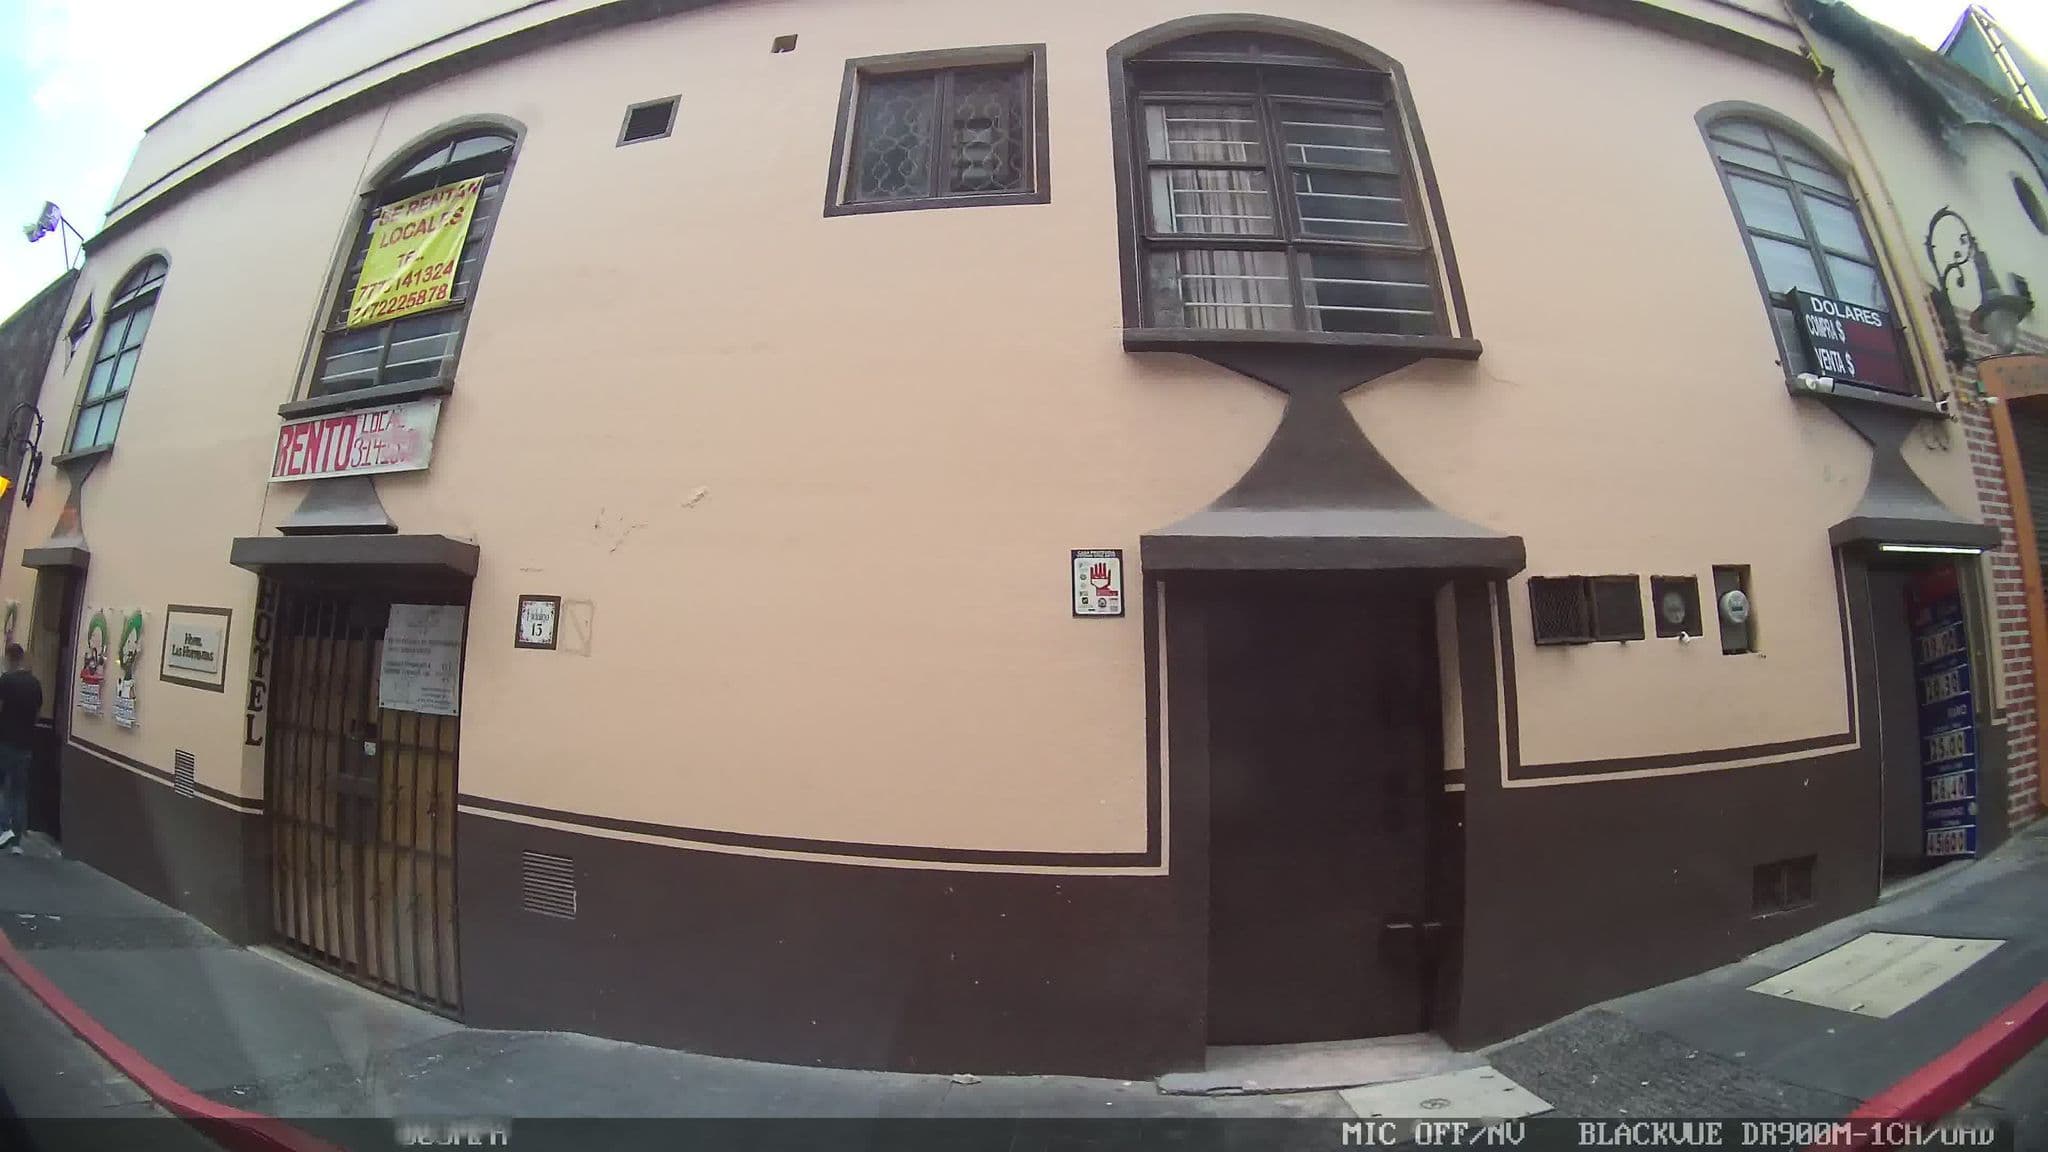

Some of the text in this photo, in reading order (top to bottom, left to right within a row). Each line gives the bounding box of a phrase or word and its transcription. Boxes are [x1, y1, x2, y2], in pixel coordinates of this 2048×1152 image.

[1810, 296, 1882, 327] DOLARES
[1805, 313, 1838, 341] COMPRA
[1814, 346, 1846, 374] VENTA
[272, 414, 358, 478] RENTO
